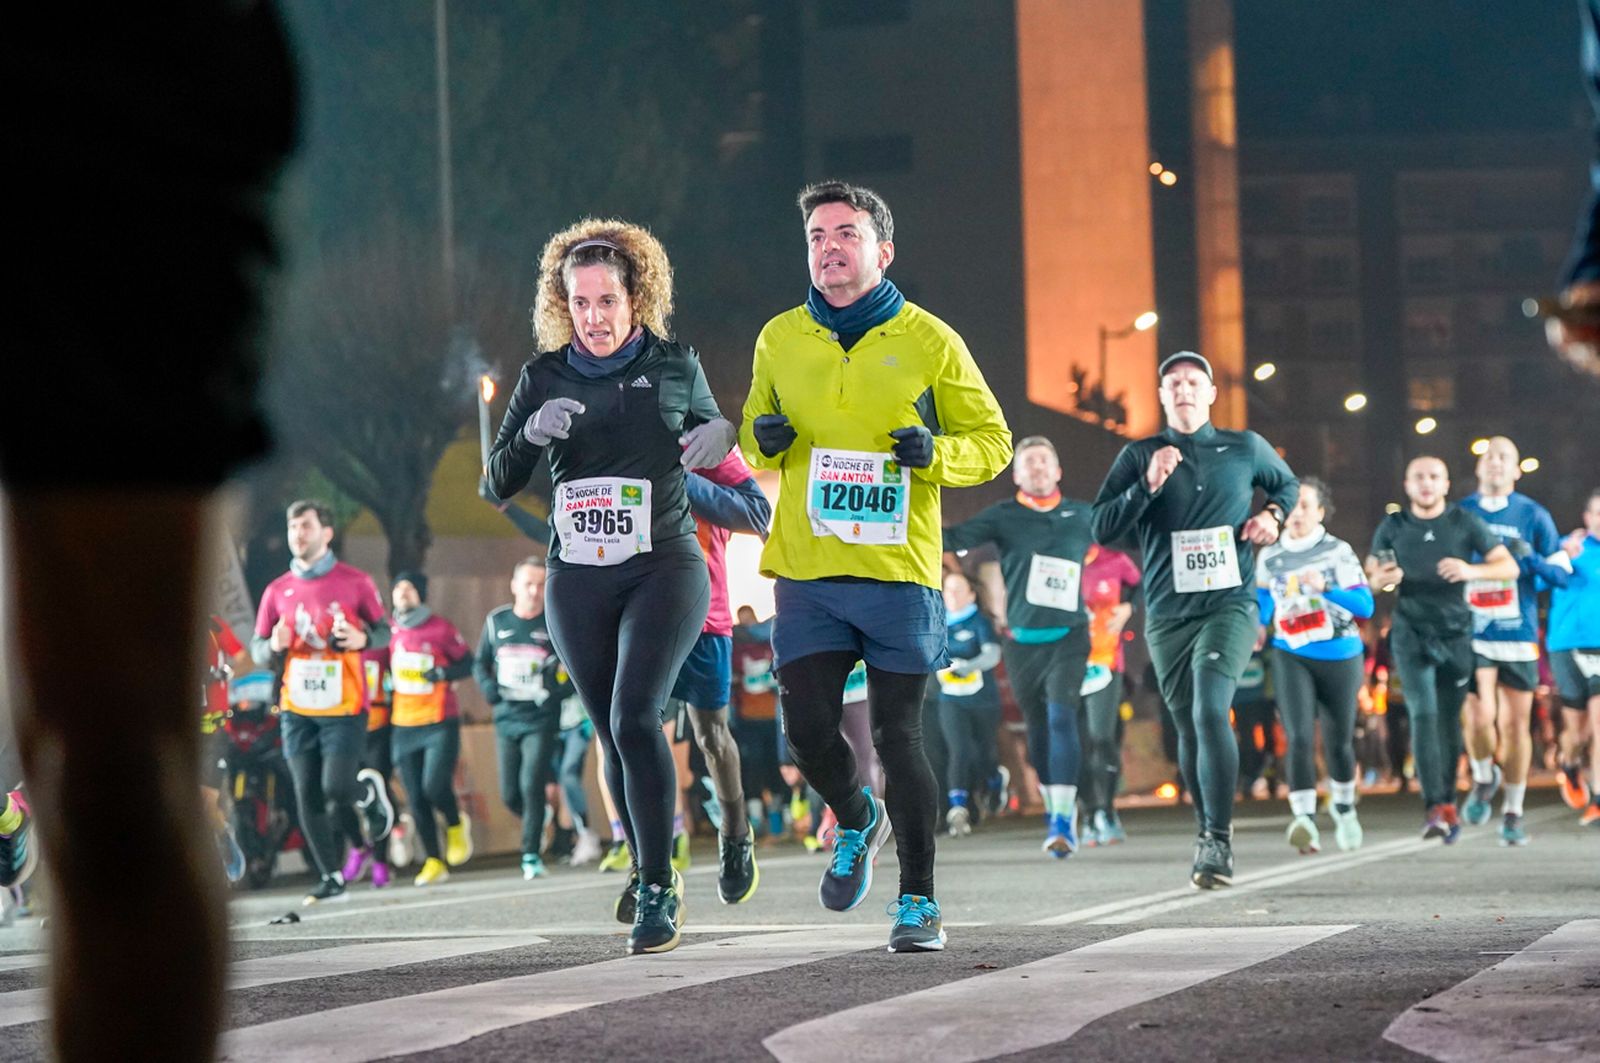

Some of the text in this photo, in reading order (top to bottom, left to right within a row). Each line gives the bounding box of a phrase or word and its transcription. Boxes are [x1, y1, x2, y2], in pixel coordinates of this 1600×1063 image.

[833, 460, 861, 471] NOCHE
[863, 462, 874, 472] DE
[820, 471, 839, 481] SAN
[575, 487, 599, 499] NOCHE
[601, 487, 612, 496] DE
[821, 483, 897, 513] 12046
[566, 500, 584, 511] SAN
[571, 509, 633, 535] 3965
[1186, 550, 1226, 571] 6934
